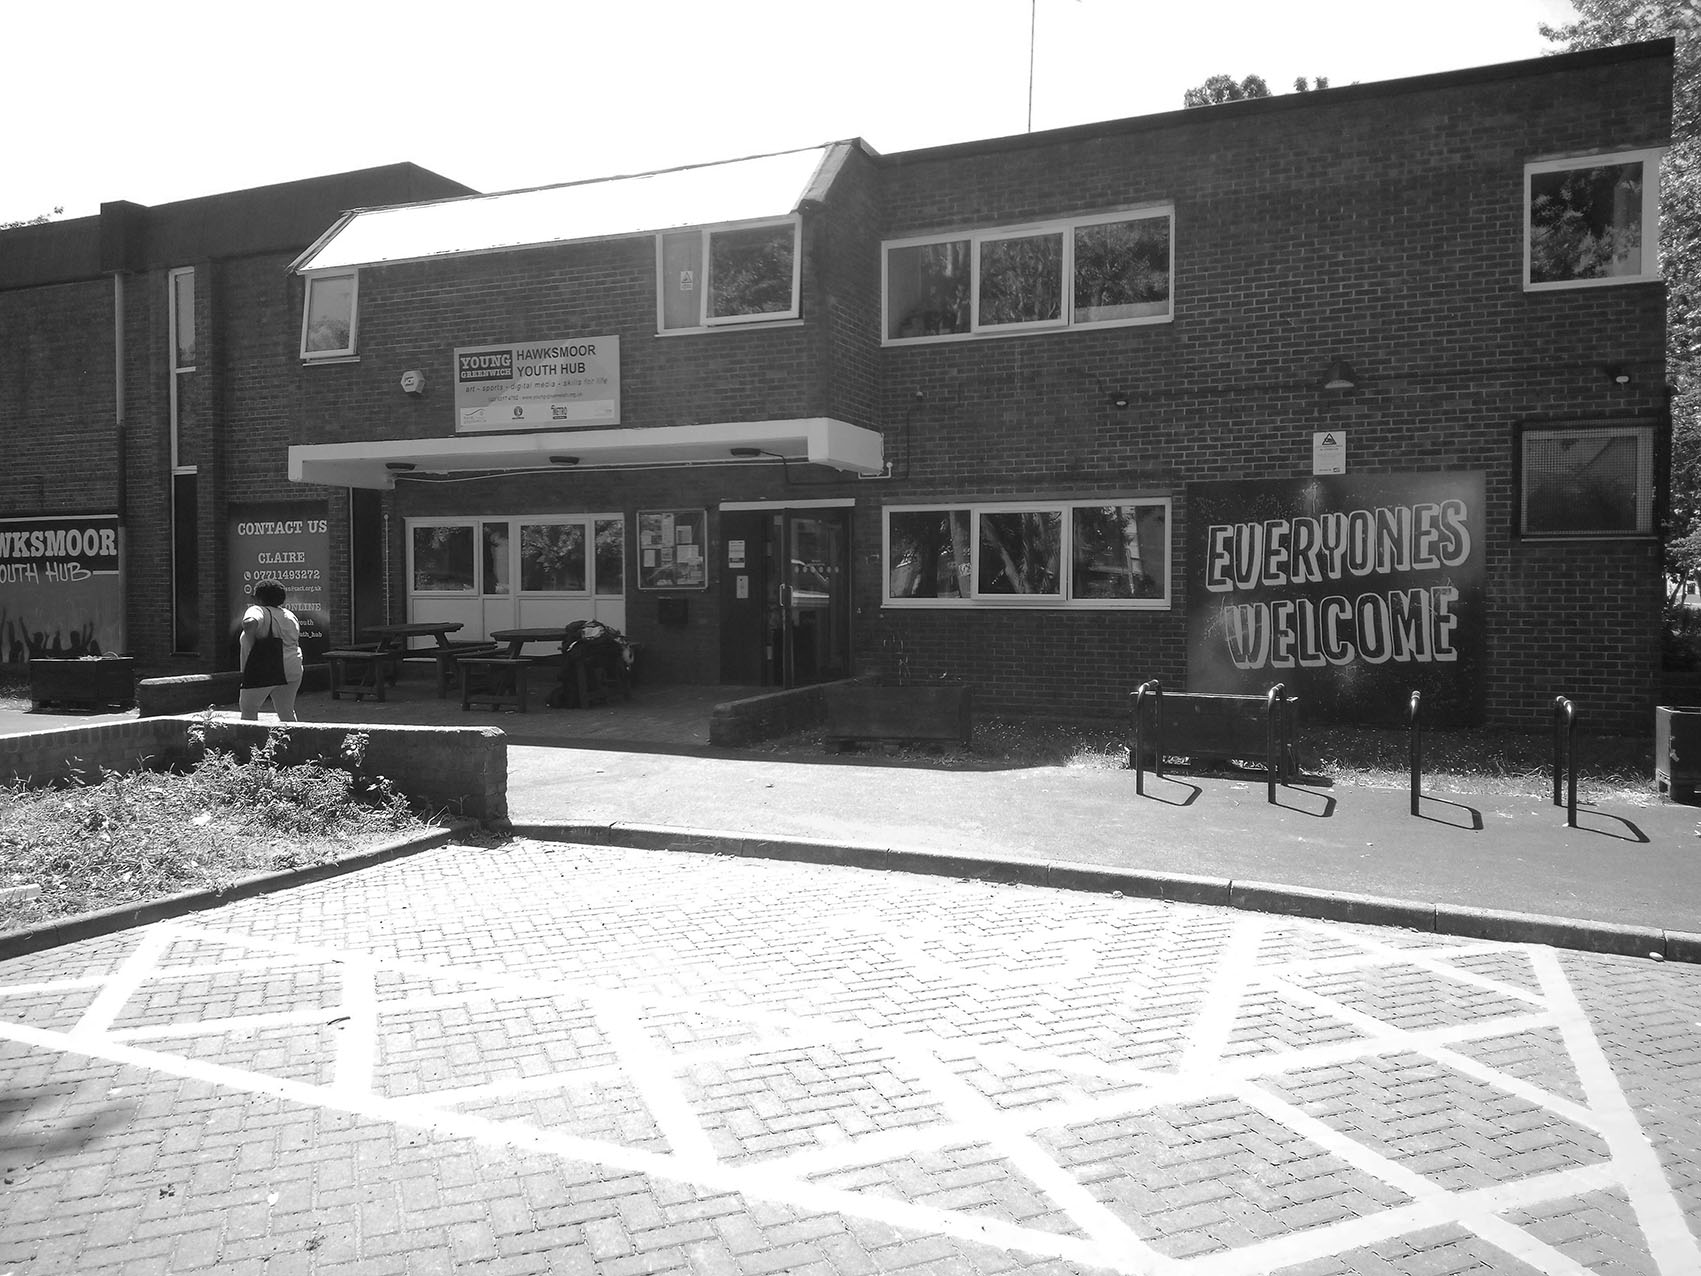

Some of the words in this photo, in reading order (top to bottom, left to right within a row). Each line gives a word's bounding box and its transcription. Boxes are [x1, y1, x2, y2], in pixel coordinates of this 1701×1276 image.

[516, 344, 596, 361] HAWKSMOOR
[460, 354, 512, 369] YOUNG
[460, 368, 512, 379] GREENWICH
[517, 364, 557, 377] YOUTH
[561, 362, 586, 375] HUB
[482, 384, 504, 393] sports
[510, 382, 533, 392] digital
[563, 378, 582, 386] skills
[583, 377, 595, 385] for
[596, 376, 608, 385] life
[237, 521, 303, 535] CONTACT
[307, 520, 328, 533] US
[0, 529, 117, 558] WKSMOOR
[1206, 499, 1471, 592] EVERYONES
[258, 551, 305, 564] CLAIRE
[45, 561, 92, 582] HUB
[253, 569, 320, 580] 07711493272
[285, 603, 321, 612] ONLINE
[299, 631, 323, 639] uth_hub
[1224, 586, 1459, 669] WELCOME
